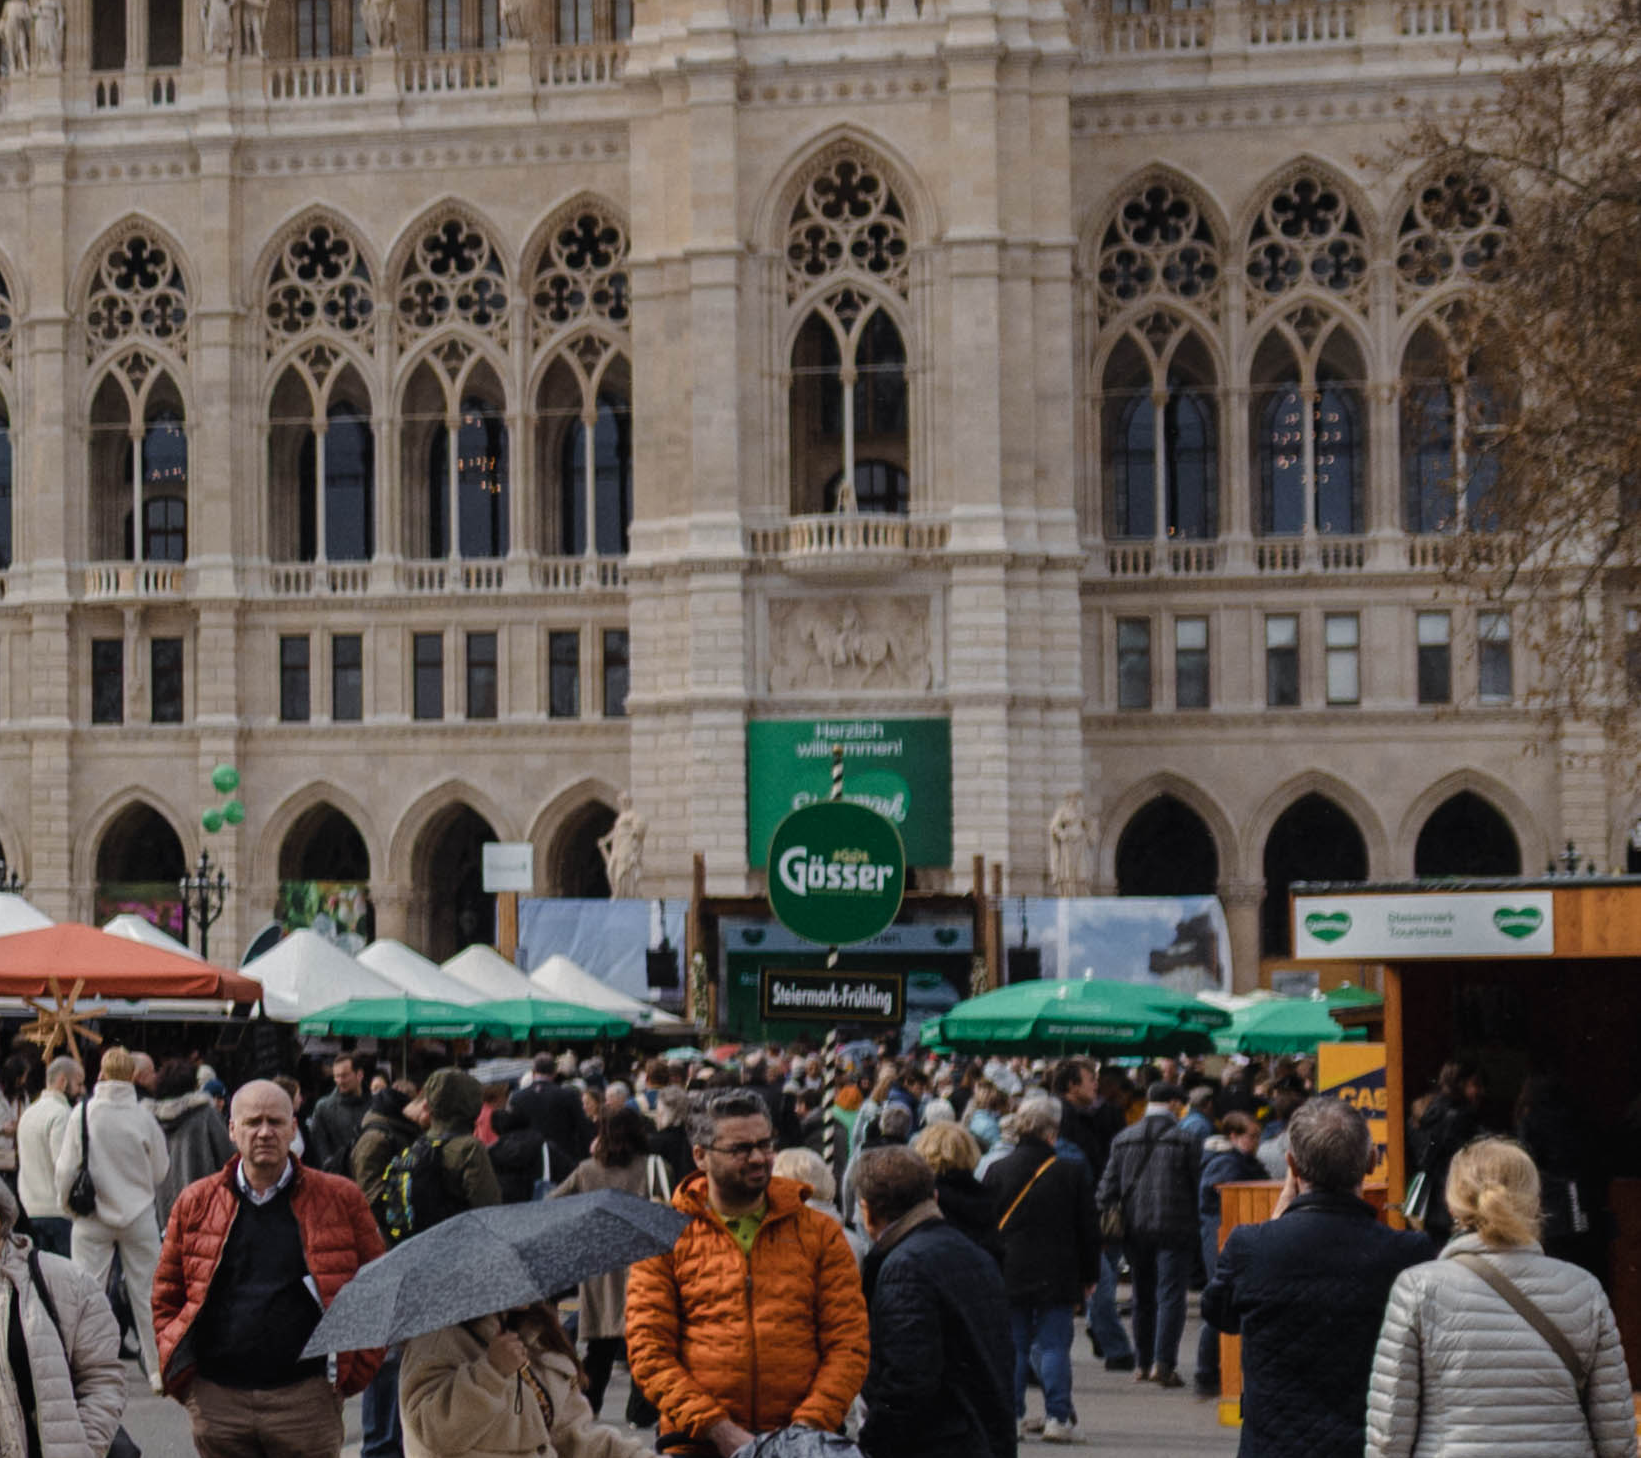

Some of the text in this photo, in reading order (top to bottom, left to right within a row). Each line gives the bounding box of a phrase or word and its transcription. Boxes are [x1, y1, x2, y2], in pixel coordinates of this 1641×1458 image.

[815, 721, 884, 739] Herzlich
[779, 845, 894, 896] Gösser
[773, 981, 892, 1015] Steiermark-Frühling
